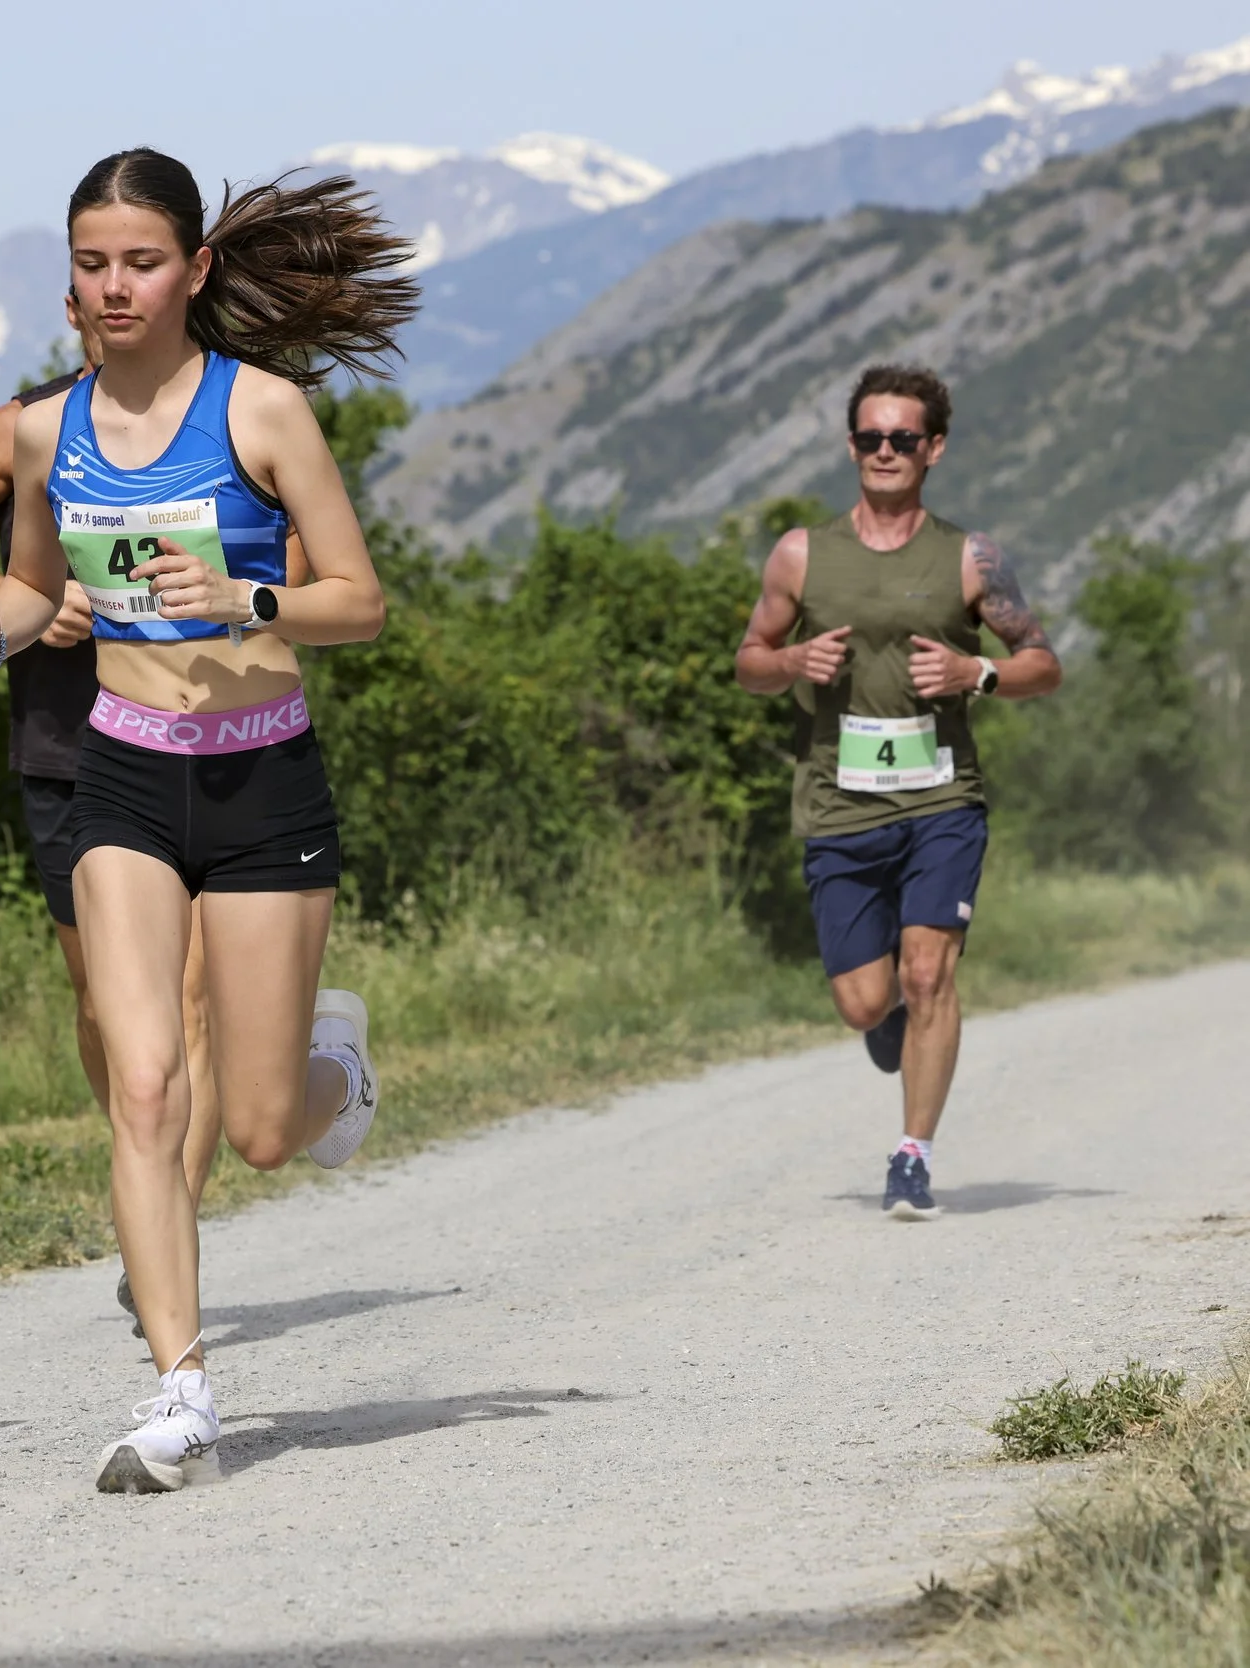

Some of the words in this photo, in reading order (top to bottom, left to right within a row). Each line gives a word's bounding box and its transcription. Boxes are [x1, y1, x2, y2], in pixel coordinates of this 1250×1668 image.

[59, 469, 85, 480] erima
[70, 511, 83, 524] stv
[92, 514, 125, 528] gampel
[147, 506, 202, 526] lonzalauf
[113, 707, 203, 745] PRO
[216, 696, 306, 744] NIKE
[876, 739, 897, 767] 4
